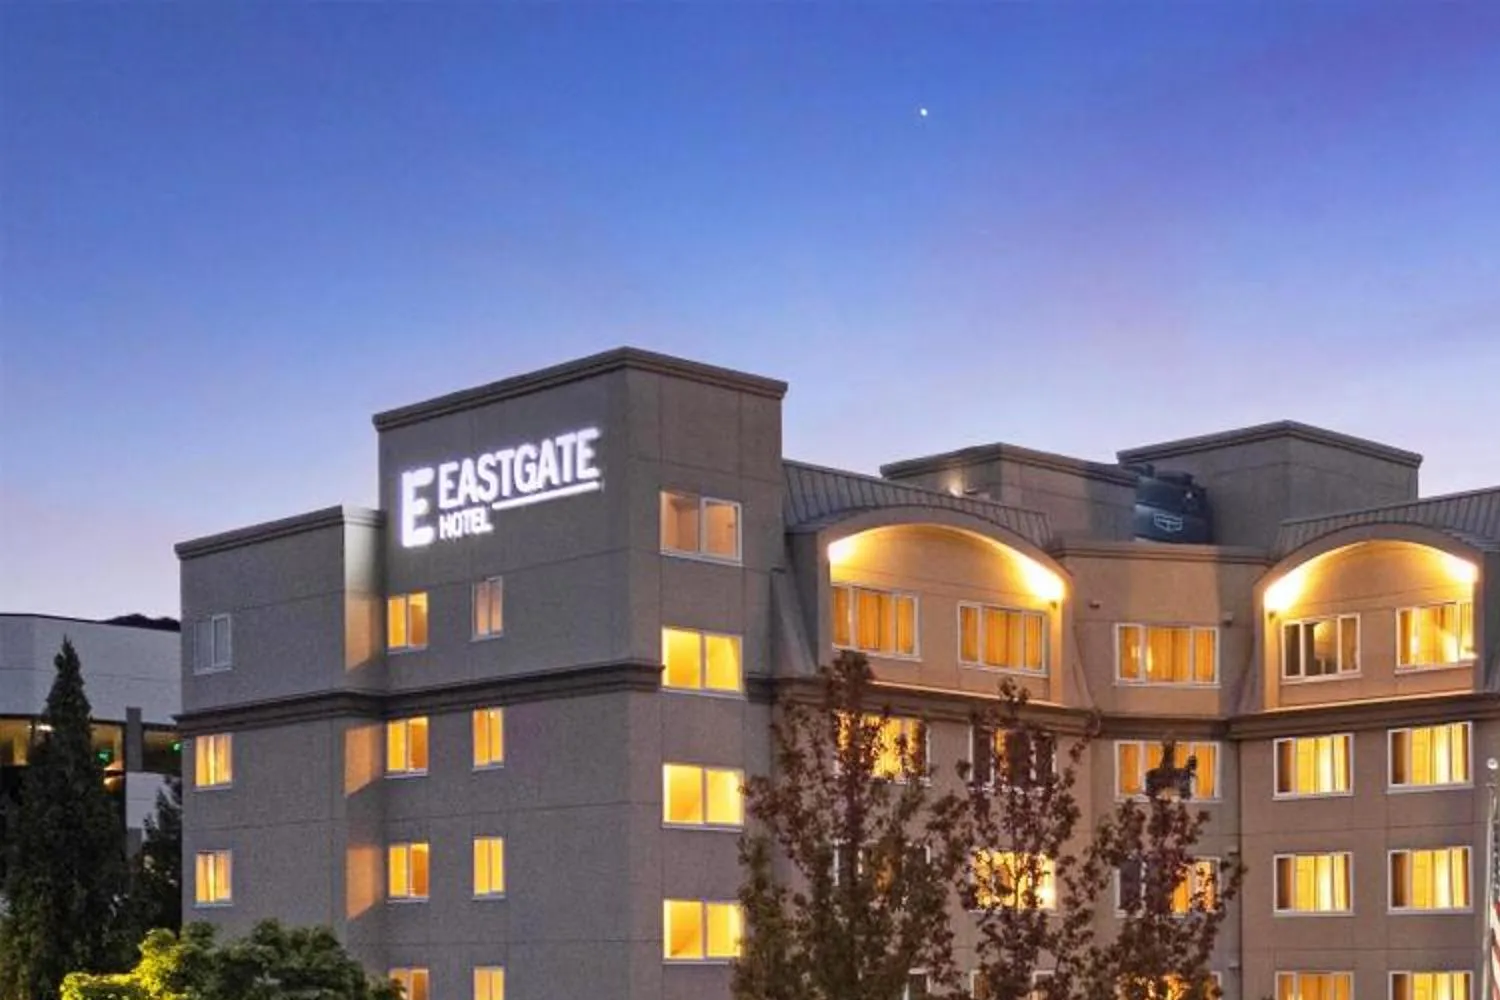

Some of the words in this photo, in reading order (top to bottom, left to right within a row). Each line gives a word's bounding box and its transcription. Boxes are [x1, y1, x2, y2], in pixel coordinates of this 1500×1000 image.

[401, 467, 435, 548] E
[438, 427, 600, 509] EASTGATE
[439, 506, 494, 541] HOTEL
